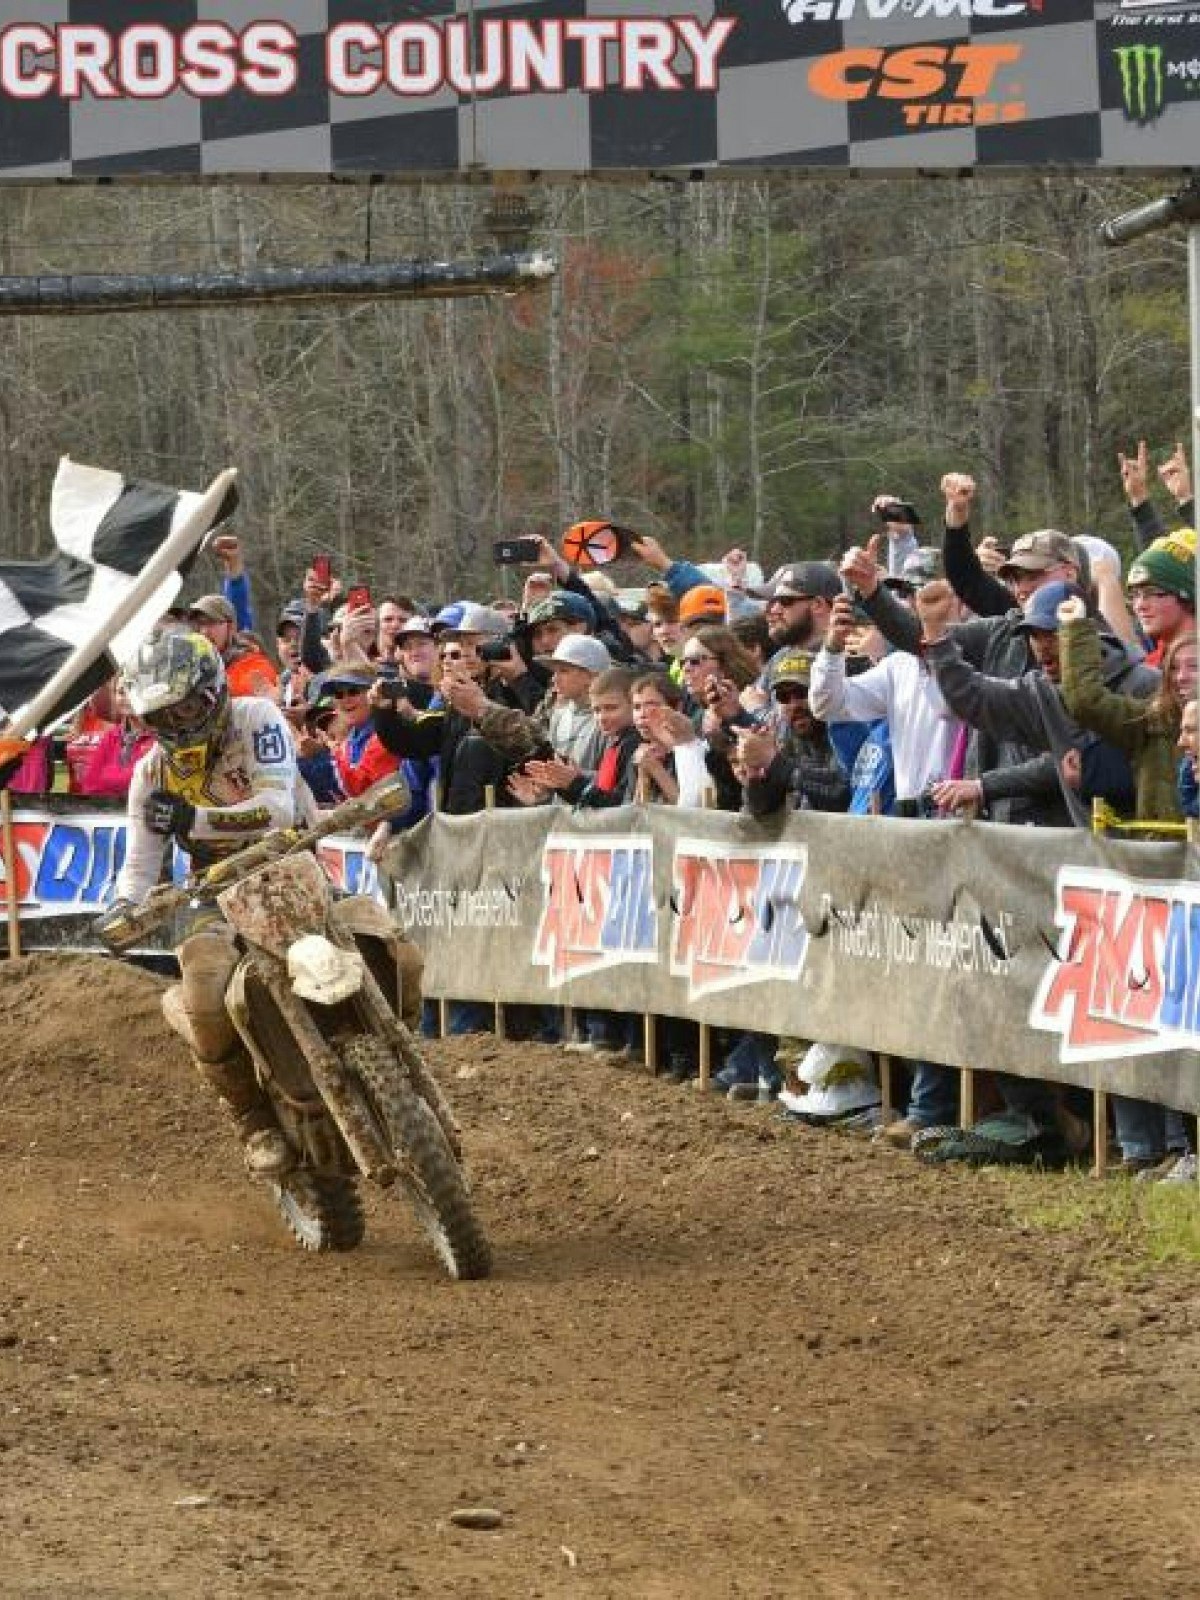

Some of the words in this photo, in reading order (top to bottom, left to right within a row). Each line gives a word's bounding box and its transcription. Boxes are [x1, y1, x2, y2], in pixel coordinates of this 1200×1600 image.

[325, 15, 737, 95] COUNTRY
[807, 44, 1023, 100] CST
[902, 100, 1026, 125] TIRES
